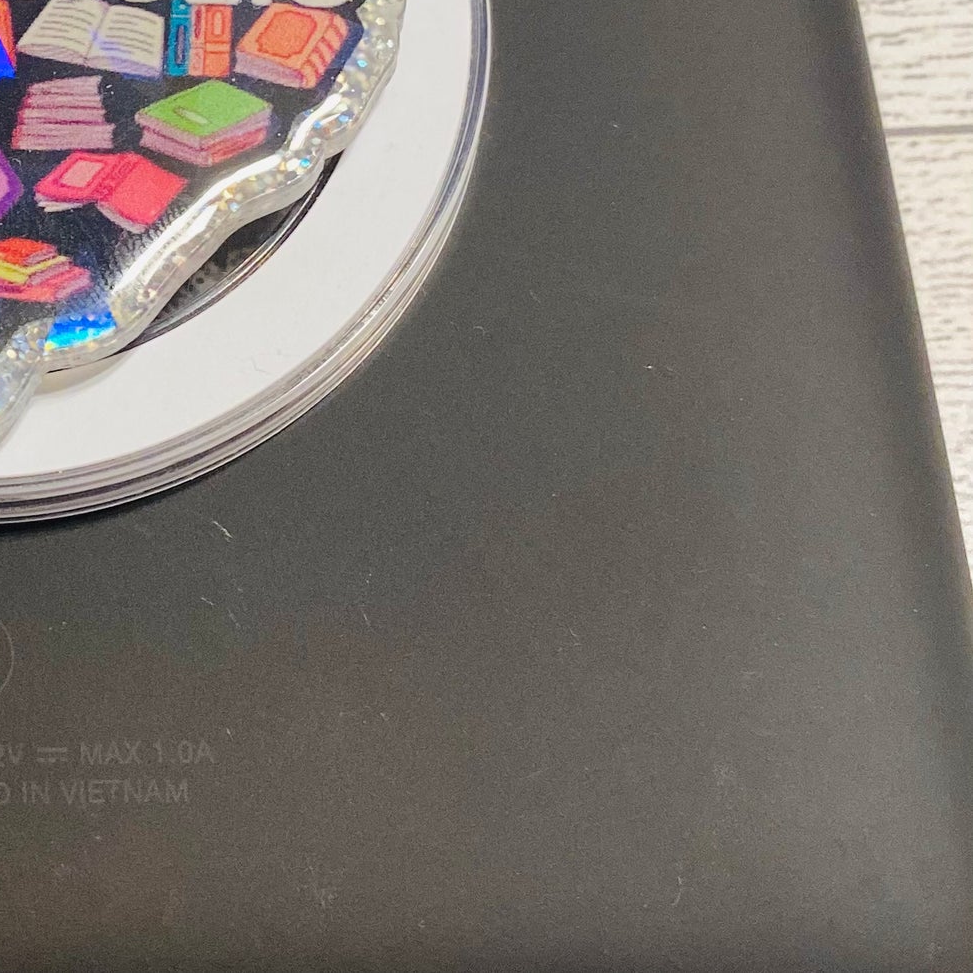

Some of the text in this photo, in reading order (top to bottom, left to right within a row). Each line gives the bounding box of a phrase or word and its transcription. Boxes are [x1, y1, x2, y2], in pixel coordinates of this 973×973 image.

[80, 738, 142, 765] MAX
[22, 781, 49, 804] IN
[59, 778, 190, 806] VIETNAM
